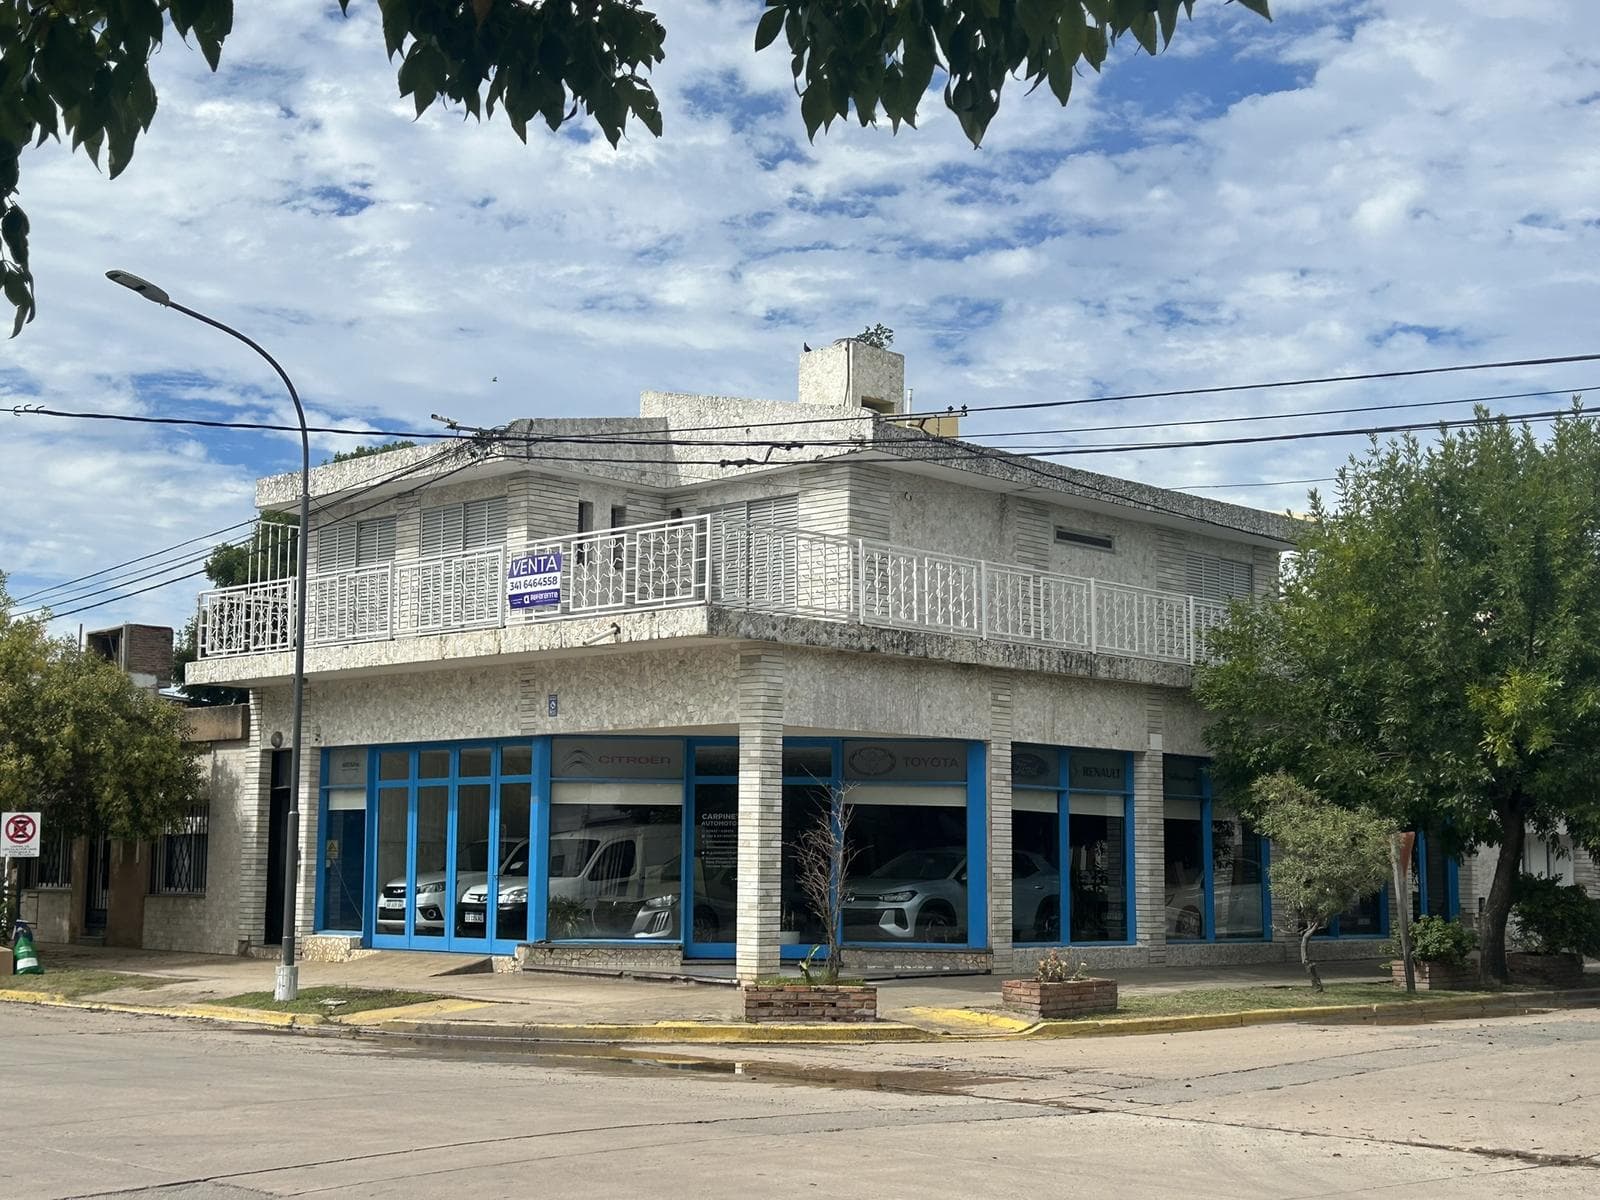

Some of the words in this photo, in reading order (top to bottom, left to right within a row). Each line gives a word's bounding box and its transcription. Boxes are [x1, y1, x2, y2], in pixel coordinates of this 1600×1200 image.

[513, 556, 558, 576] VENTA
[510, 581, 522, 590] 341
[524, 576, 558, 588] 6464558
[903, 756, 960, 768] TOYOTA
